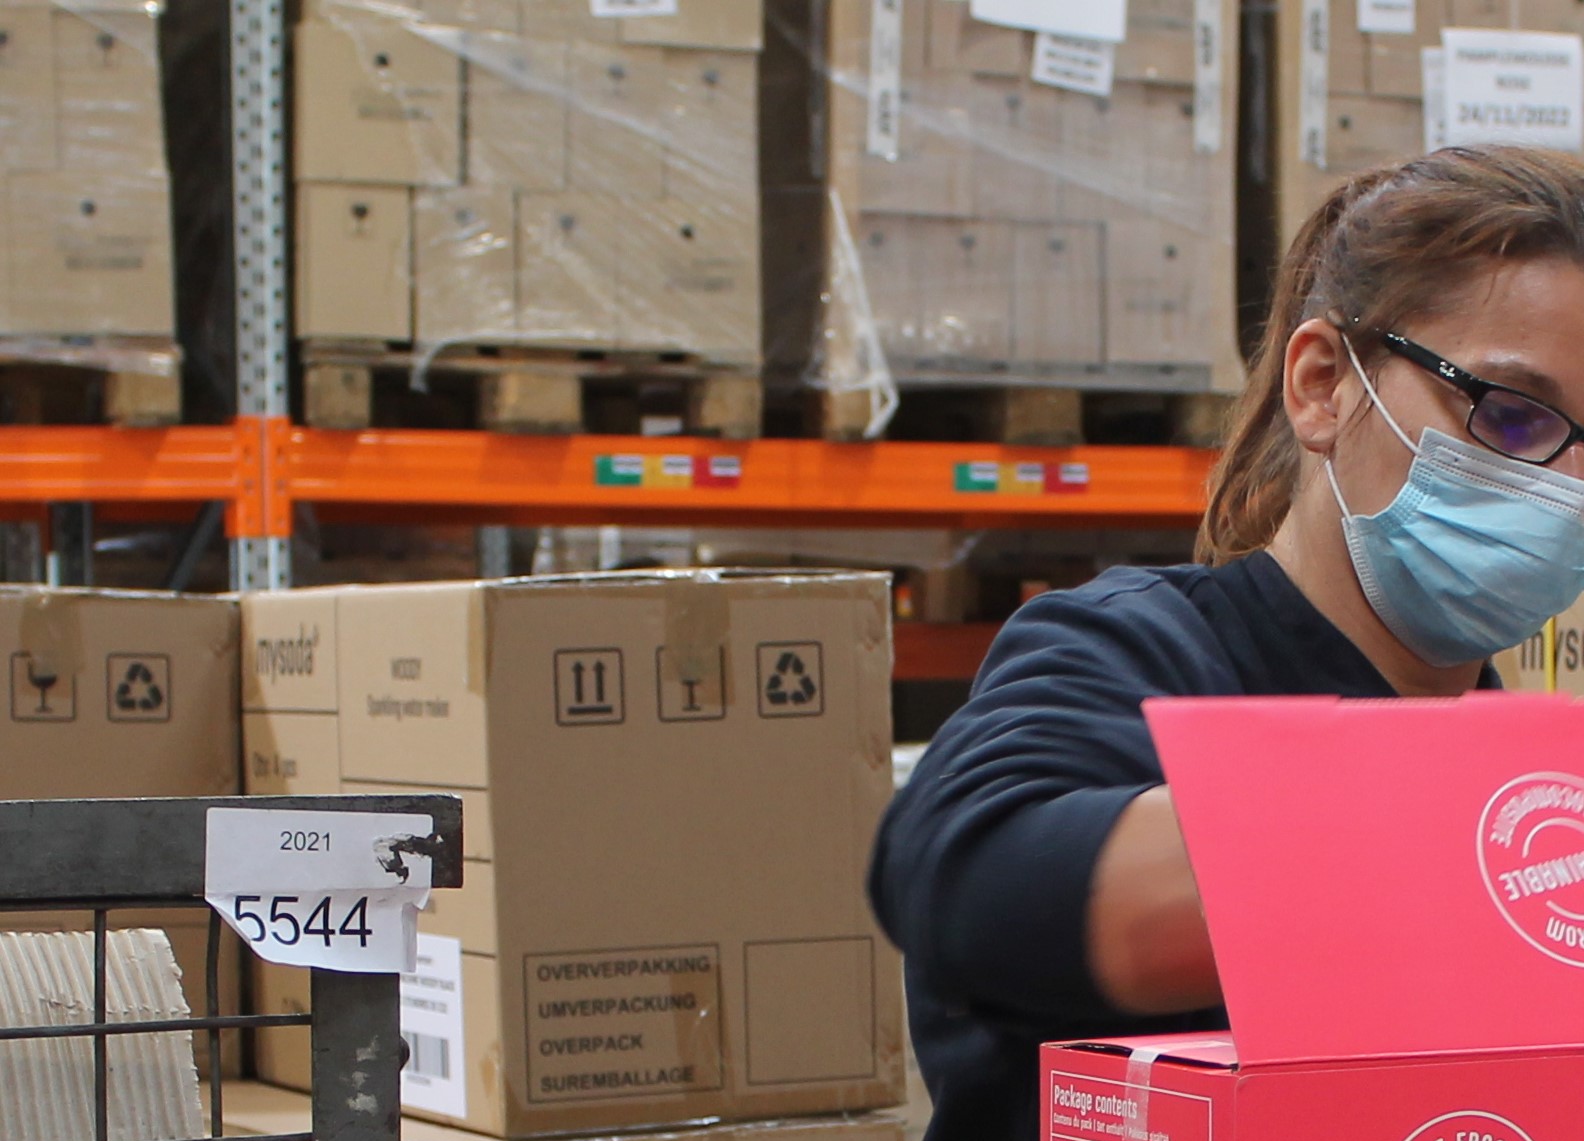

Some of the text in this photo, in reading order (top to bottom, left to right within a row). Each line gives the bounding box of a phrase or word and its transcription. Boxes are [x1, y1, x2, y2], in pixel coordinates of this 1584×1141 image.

[280, 831, 332, 853] 2021
[233, 895, 372, 948] 5544
[537, 956, 711, 982] OVERVERPAKKING
[538, 993, 697, 1020] UMVERPACKUNG
[539, 1034, 644, 1056] OVERPACK
[540, 1066, 695, 1093] SUREMBALLAGE
[1054, 1084, 1138, 1120] Package contents
